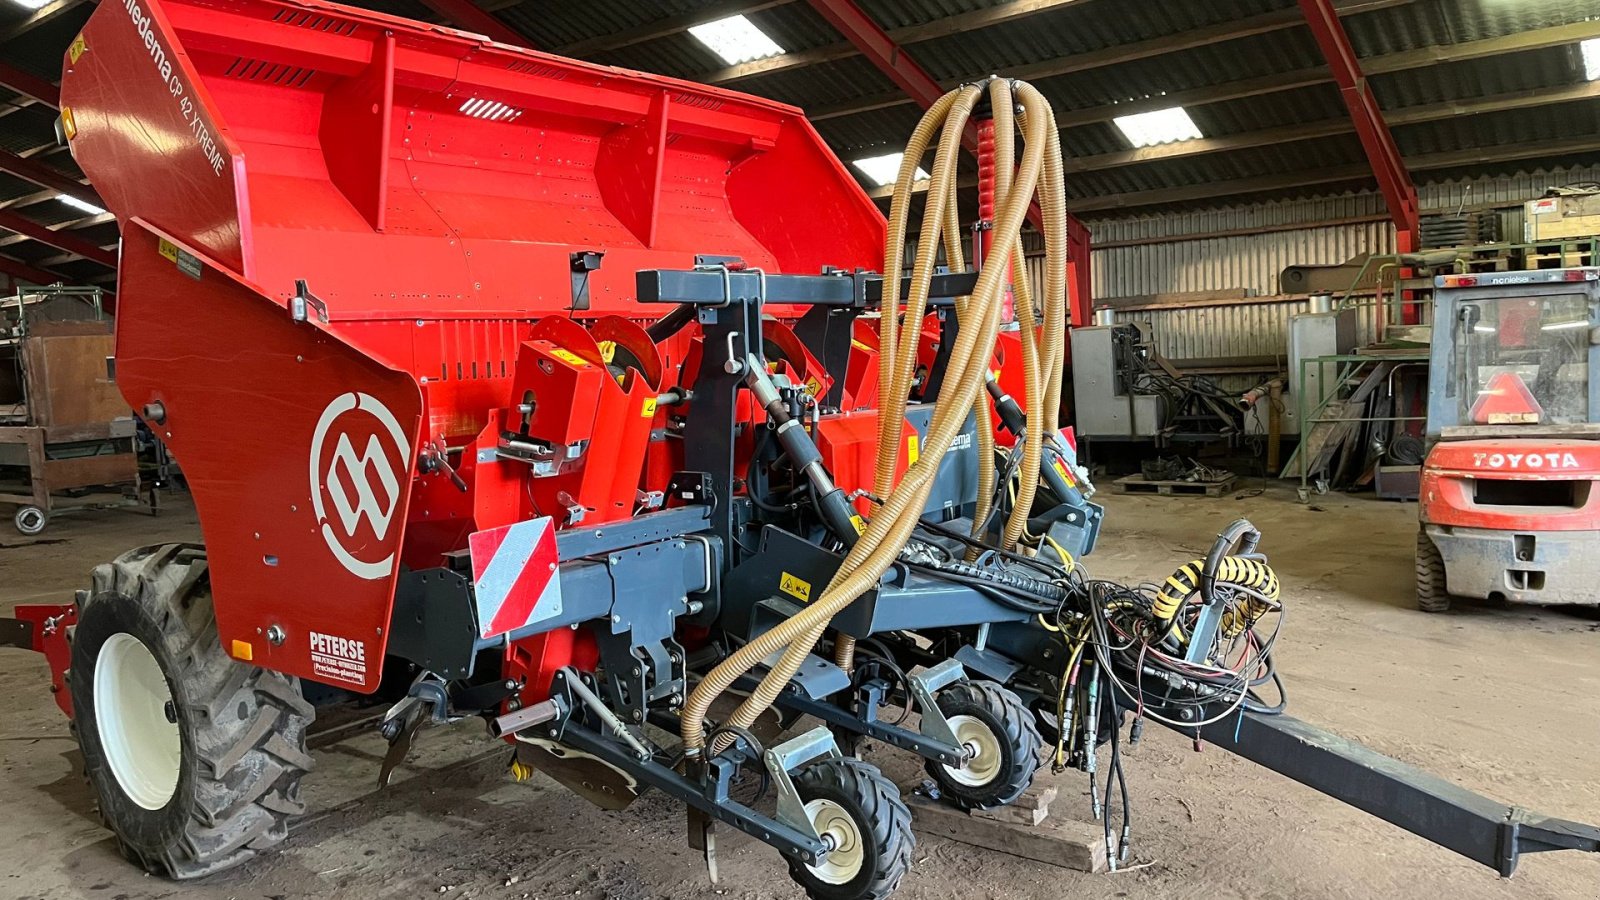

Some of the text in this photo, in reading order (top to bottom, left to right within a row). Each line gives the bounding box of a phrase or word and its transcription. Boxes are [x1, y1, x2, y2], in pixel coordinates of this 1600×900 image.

[169, 75, 183, 97] CP
[180, 96, 193, 120] 42
[190, 112, 225, 176] XTREME
[1473, 453, 1579, 468] TOYOTA
[310, 631, 365, 661] PETERSE
